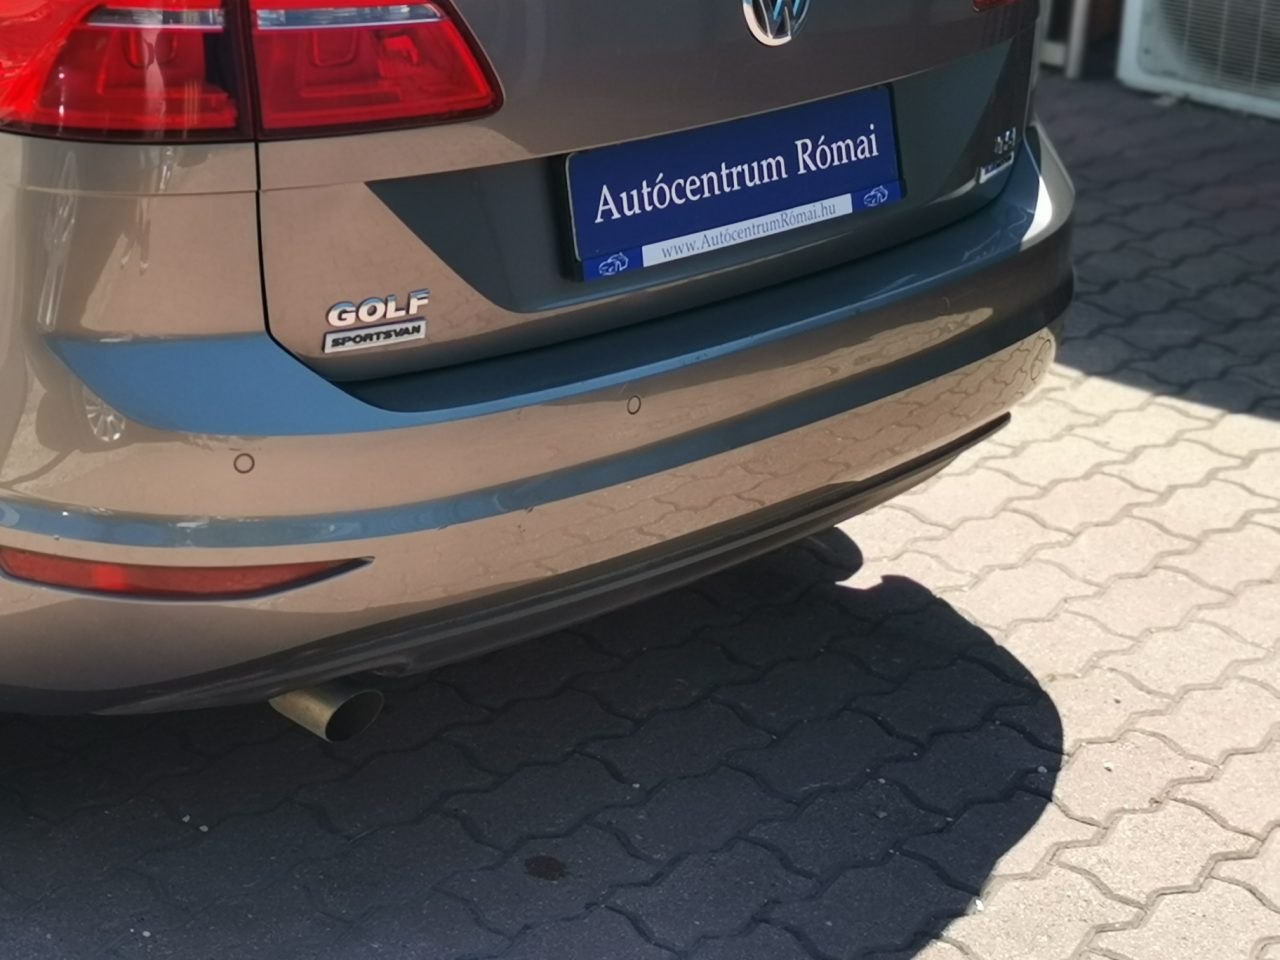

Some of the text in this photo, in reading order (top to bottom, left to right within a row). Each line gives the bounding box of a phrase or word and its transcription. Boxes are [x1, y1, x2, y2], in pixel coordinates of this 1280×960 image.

[594, 123, 880, 224] Autócentrum Római
[661, 200, 837, 260] www.AutócentrumRómai.hu
[327, 288, 431, 327] GOLF
[330, 324, 422, 348] SPORTSVAN
